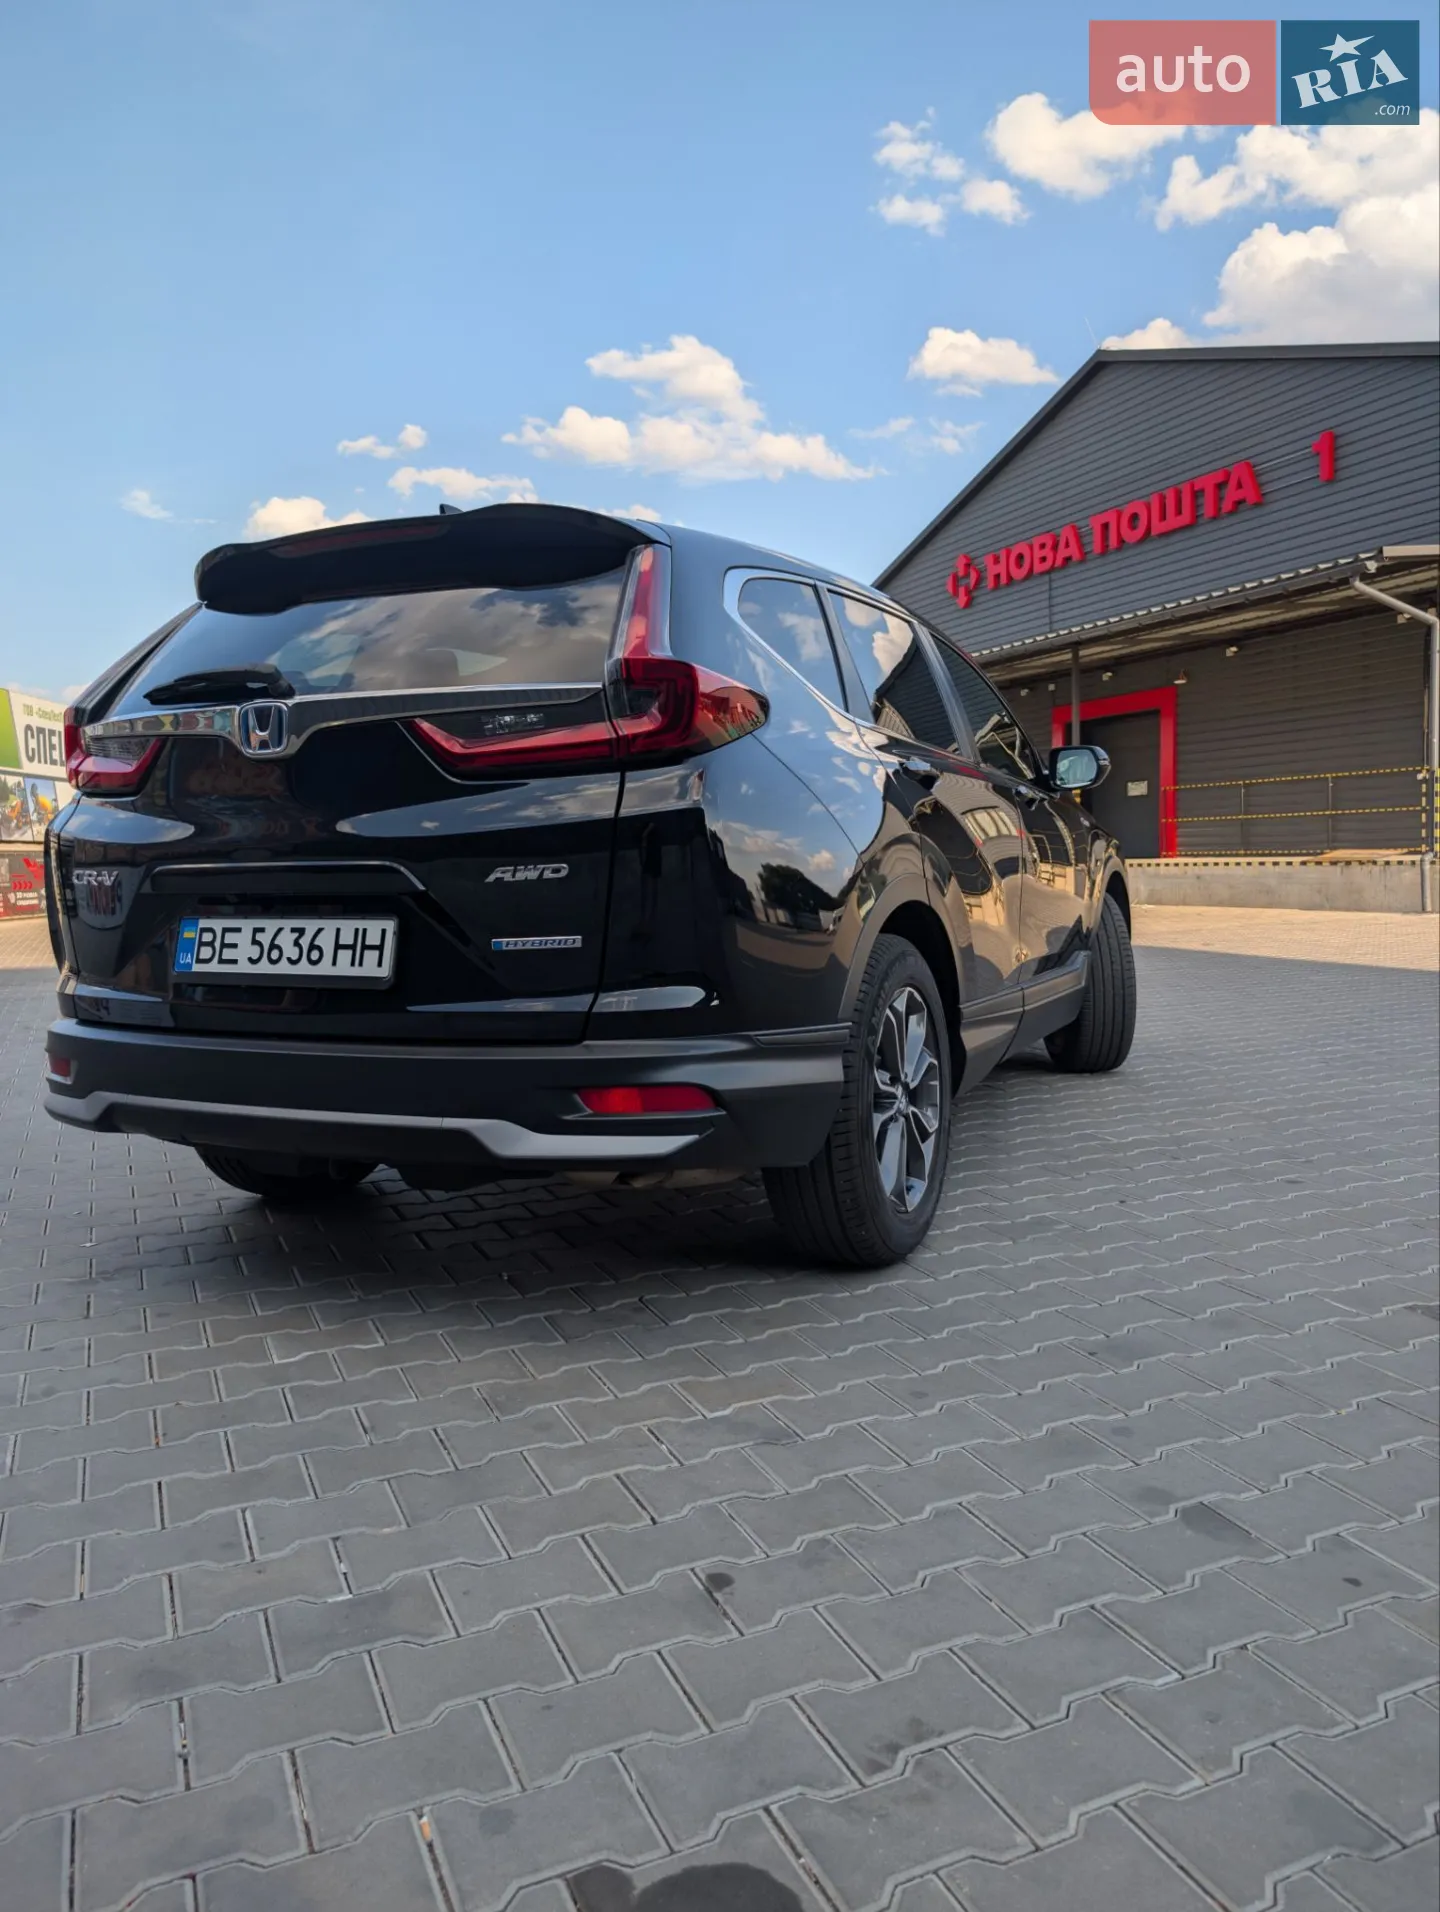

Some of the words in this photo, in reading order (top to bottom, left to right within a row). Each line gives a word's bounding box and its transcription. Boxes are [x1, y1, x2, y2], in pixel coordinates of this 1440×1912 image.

[983, 523, 1086, 591] НОВА
[1089, 460, 1264, 556] ПОШТА
[1311, 430, 1337, 482] 1
[72, 870, 119, 886] CR-V
[484, 863, 569, 882] AWD
[194, 927, 243, 966] BE
[247, 927, 325, 966] 5636
[331, 927, 387, 968] HH
[504, 938, 577, 949] HYBRID
[179, 952, 193, 964] UA
